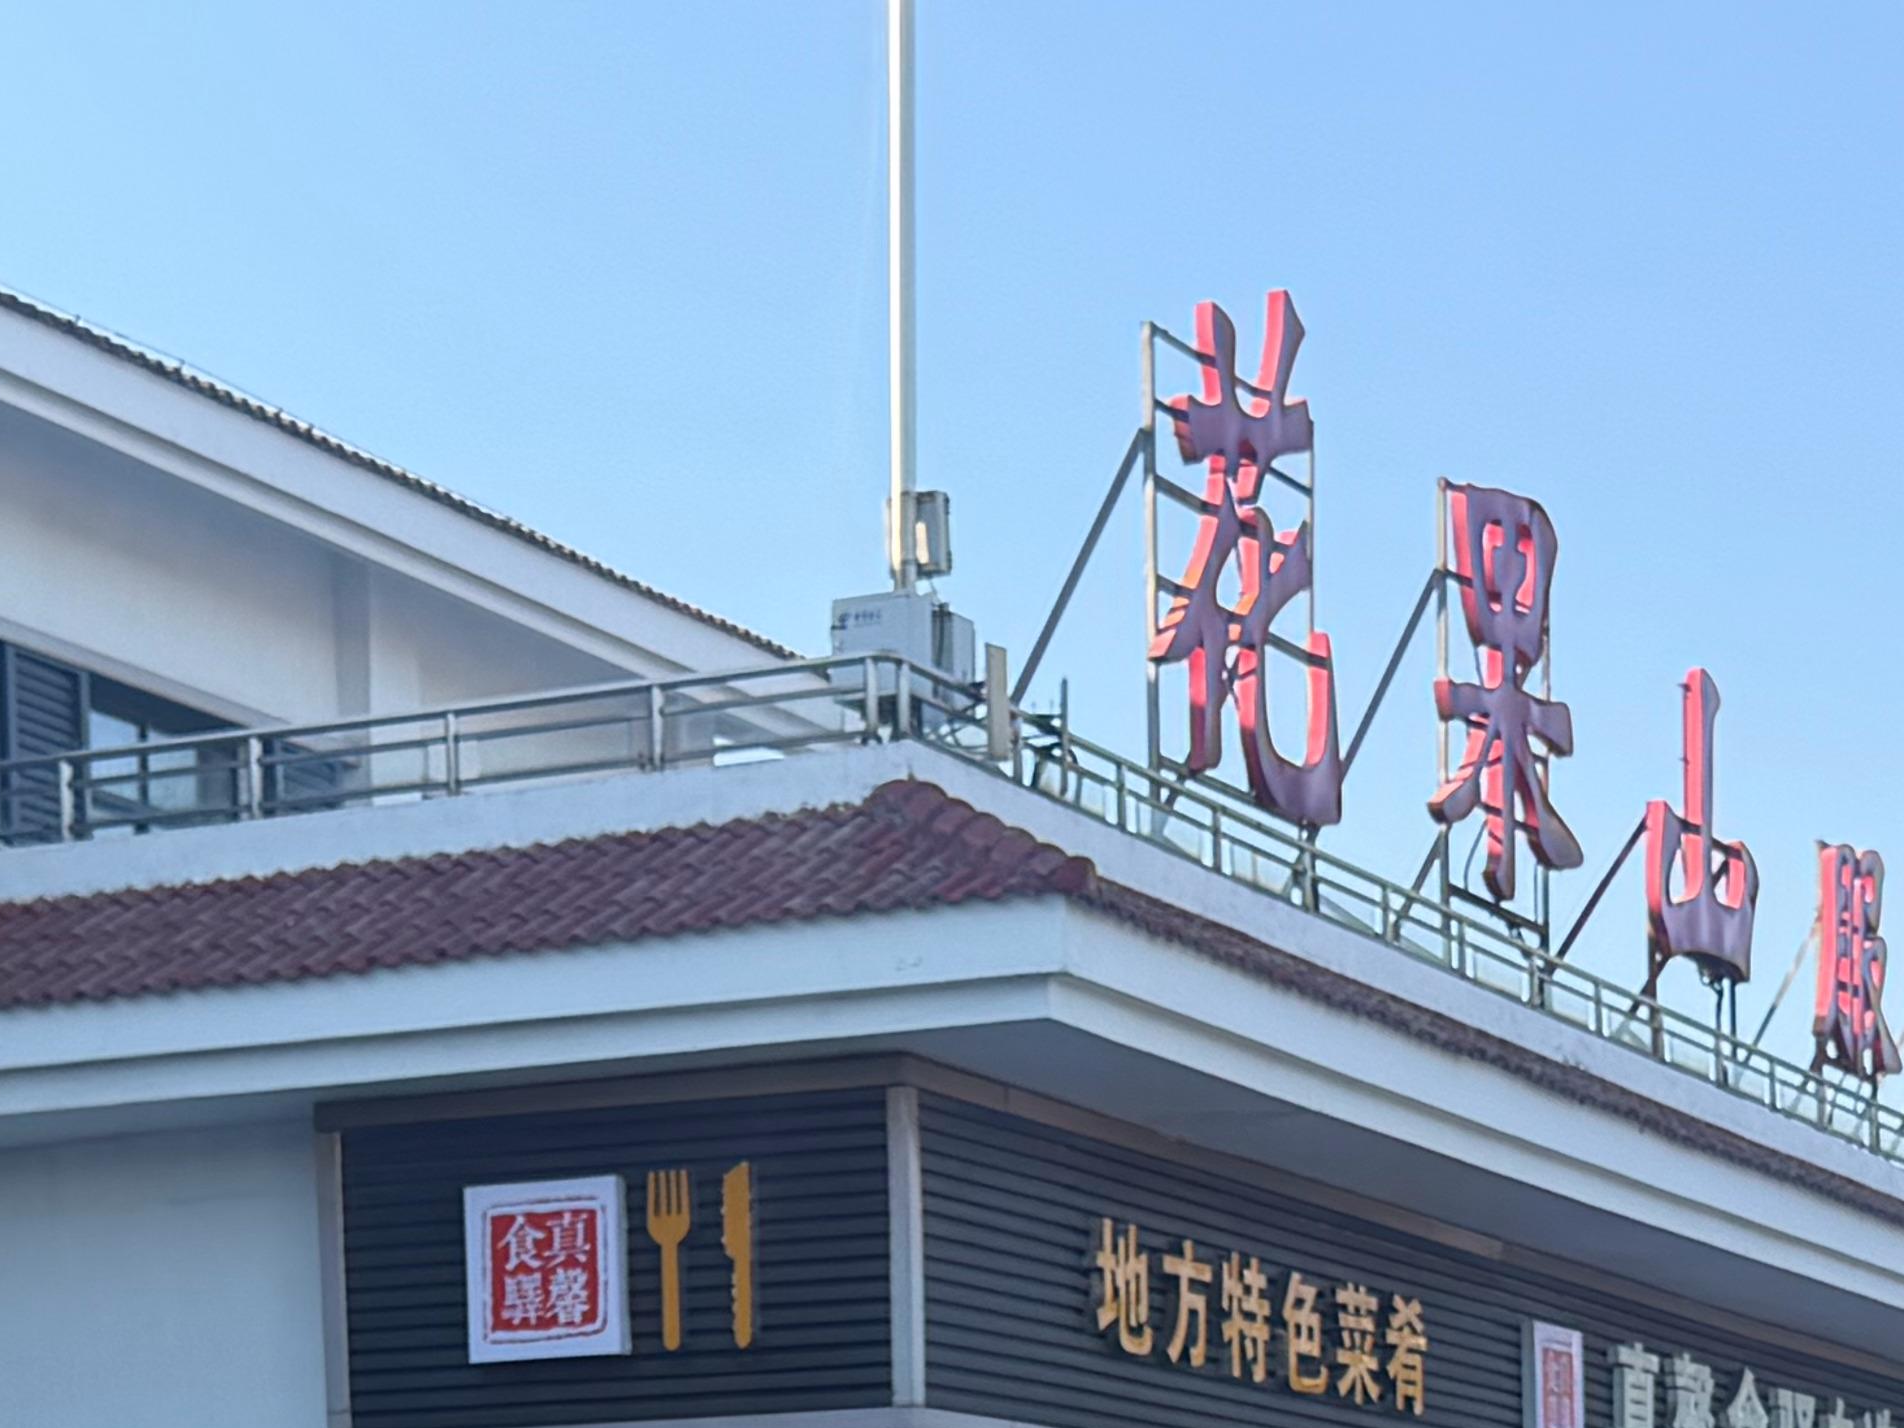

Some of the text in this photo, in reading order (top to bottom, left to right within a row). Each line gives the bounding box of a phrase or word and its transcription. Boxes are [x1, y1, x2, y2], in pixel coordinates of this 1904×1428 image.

[1096, 1217, 1429, 1417] 地方特色菜肴
